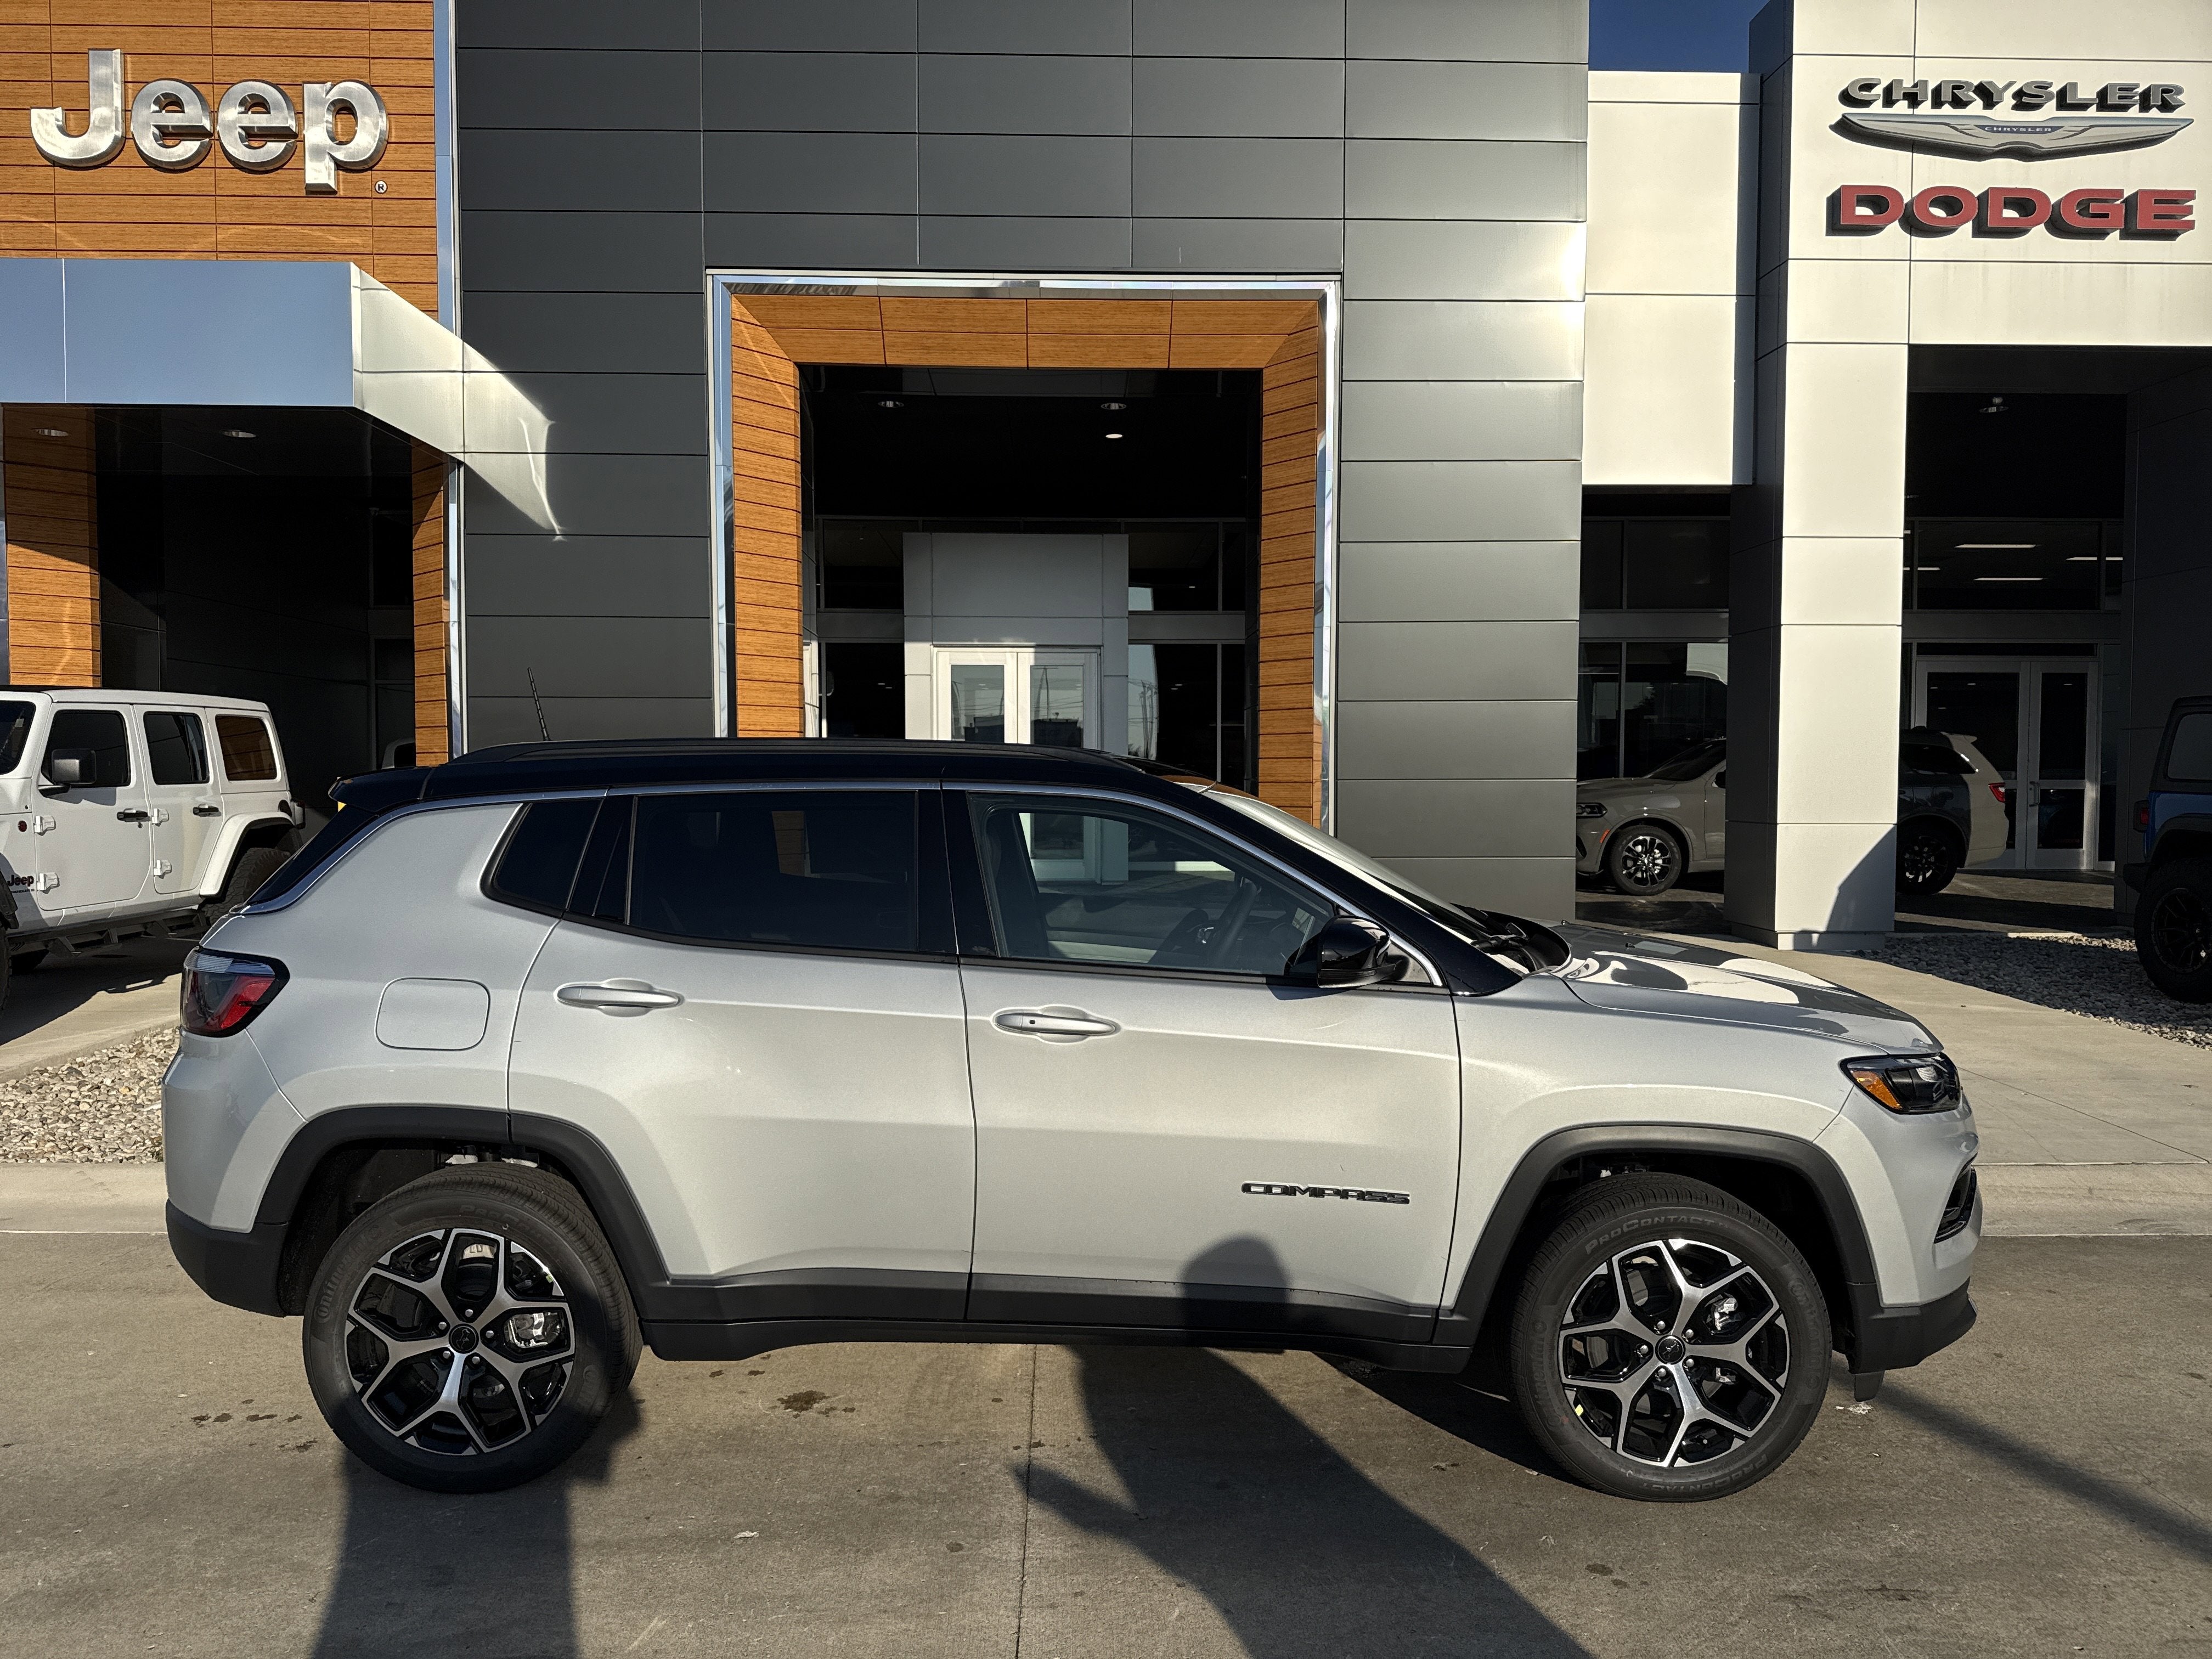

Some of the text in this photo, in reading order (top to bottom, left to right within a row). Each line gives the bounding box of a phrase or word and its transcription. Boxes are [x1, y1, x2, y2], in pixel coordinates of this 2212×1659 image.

[1842, 77, 2186, 110] CHRYSLER
[30, 48, 387, 195] Jeep
[1833, 184, 2196, 236] DODGE
[8, 874, 34, 887] Jeep
[1241, 1181, 1410, 1205] COMPASS
